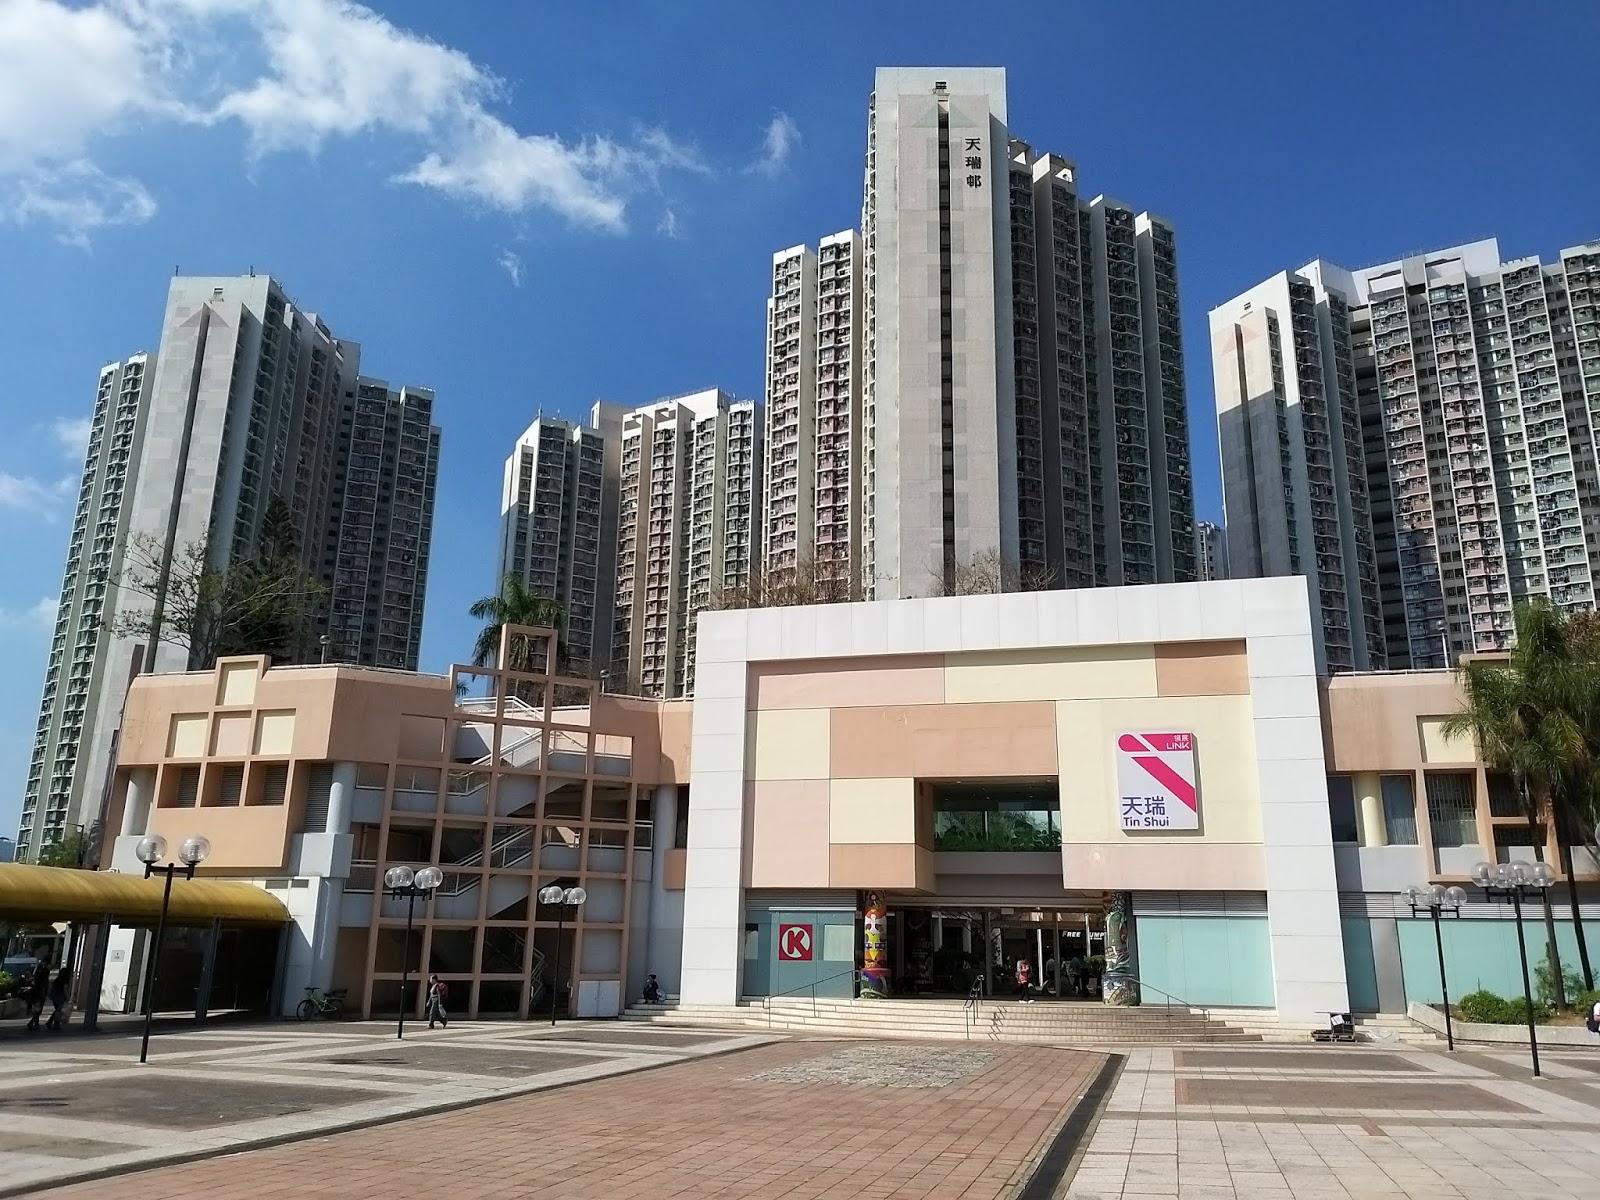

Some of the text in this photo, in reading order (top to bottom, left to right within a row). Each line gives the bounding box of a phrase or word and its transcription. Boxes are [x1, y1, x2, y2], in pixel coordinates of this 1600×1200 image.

[965, 138, 982, 188] 天瑞邨
[1166, 742, 1190, 750] LINK
[1122, 795, 1165, 816] 天瑞
[1123, 817, 1169, 827] Tin Shui
[786, 929, 811, 957] K
